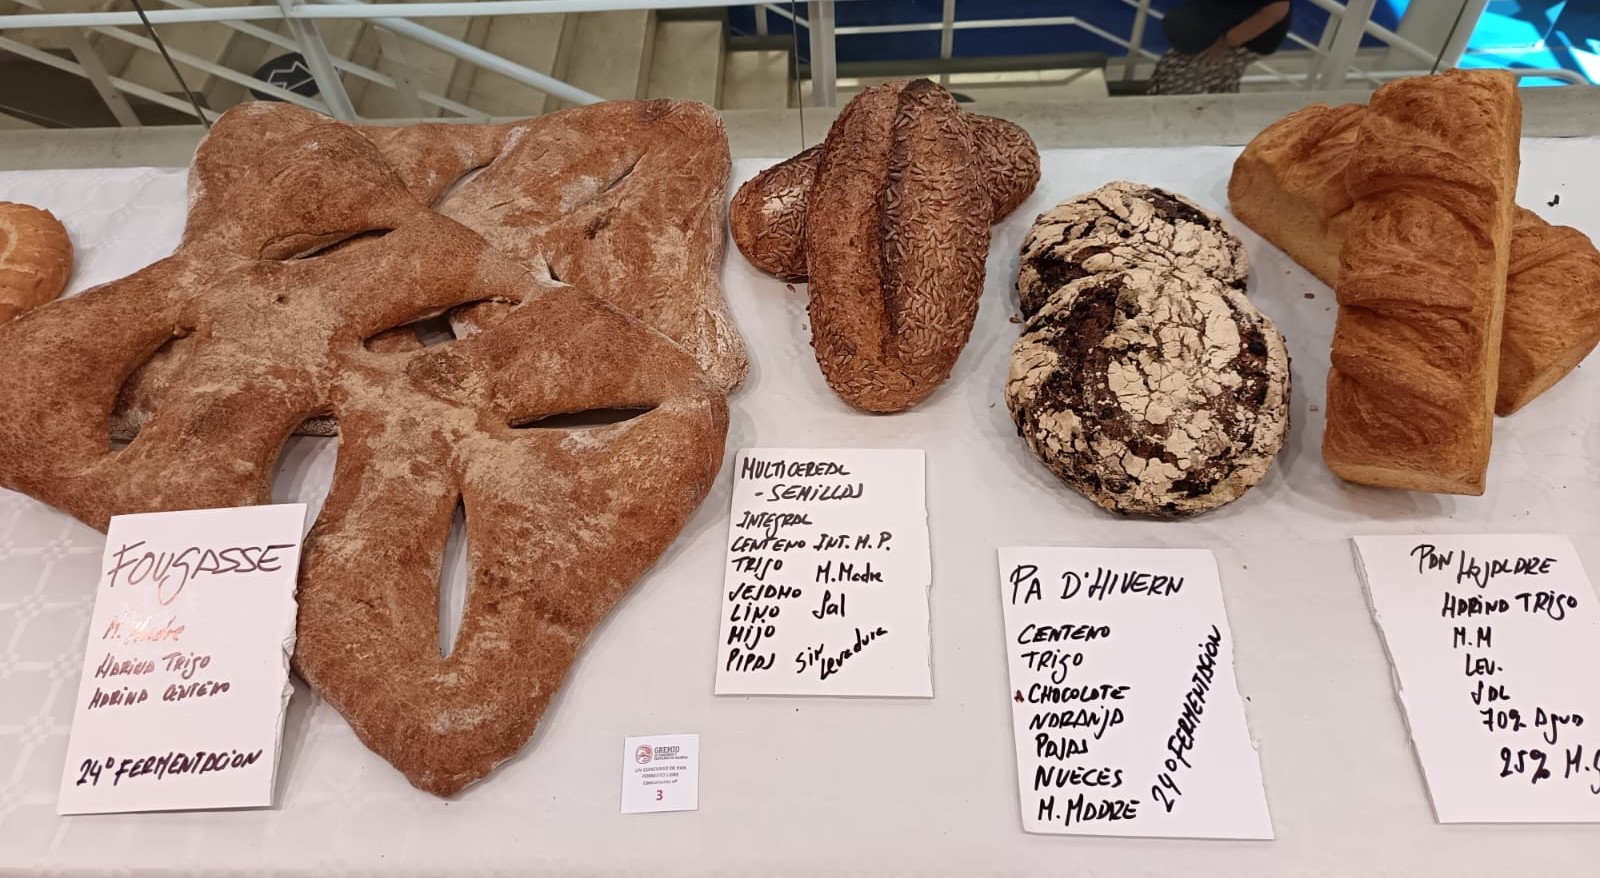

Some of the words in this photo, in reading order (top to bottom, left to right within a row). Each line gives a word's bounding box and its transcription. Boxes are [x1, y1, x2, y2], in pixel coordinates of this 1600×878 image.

[736, 511, 813, 539] INTEGRAL
[731, 536, 806, 552] CENTENO
[108, 541, 296, 606] FOUGASSE
[1010, 564, 1042, 605] PA
[1514, 590, 1578, 621] TRIGO
[1017, 623, 1111, 644] CENTENO
[1020, 649, 1084, 684] TRIGO
[1028, 683, 1130, 703] CHOCOLATE
[1029, 705, 1125, 740] NARANJA
[1034, 765, 1123, 791] NUECES
[1500, 747, 1551, 785] 25%
[656, 790, 663, 801] 3
